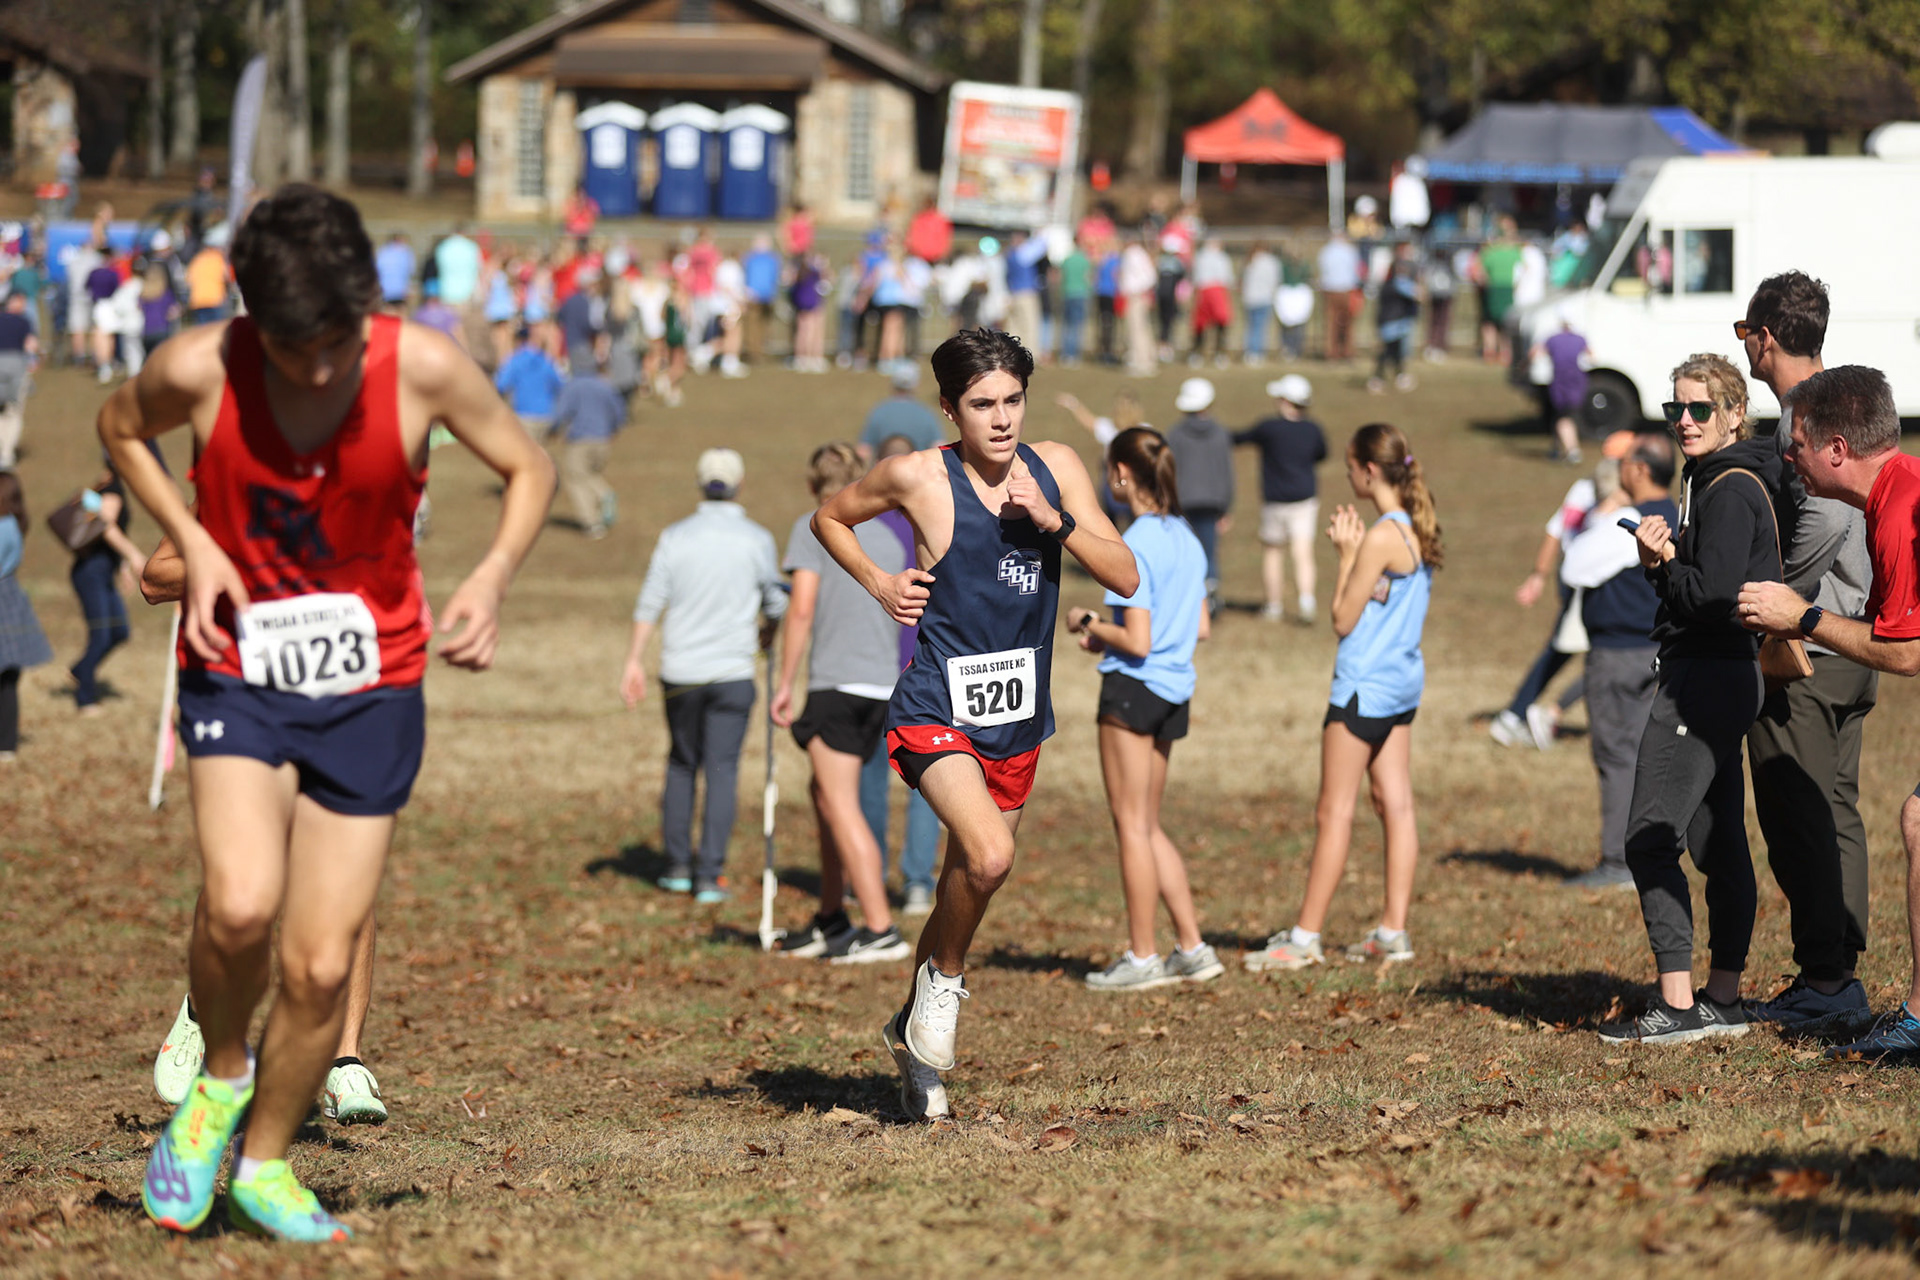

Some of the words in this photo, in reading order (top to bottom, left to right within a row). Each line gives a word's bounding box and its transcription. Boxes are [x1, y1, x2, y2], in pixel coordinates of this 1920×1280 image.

[1000, 559, 1037, 593] SBA
[253, 629, 367, 690] 1023
[959, 663, 988, 676] TSSAA
[989, 659, 1014, 673] STATE
[1015, 657, 1026, 669] XC
[966, 677, 1023, 717] 520
